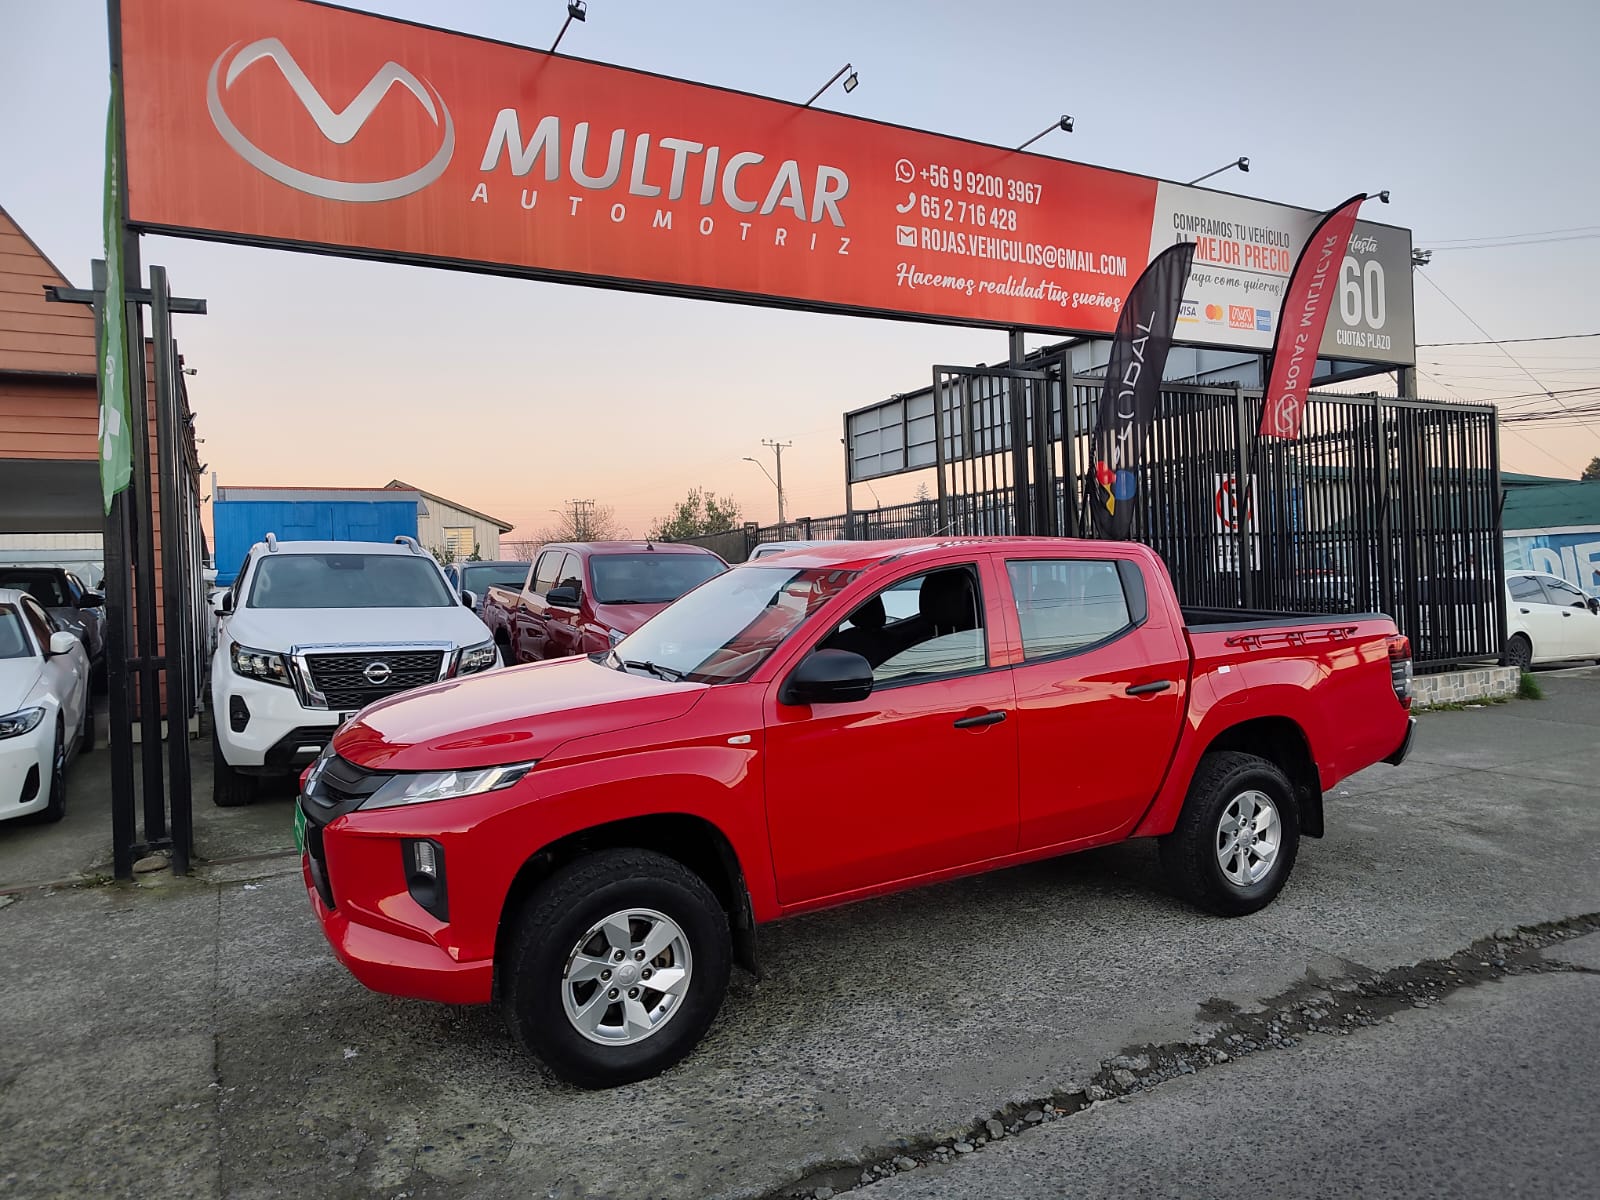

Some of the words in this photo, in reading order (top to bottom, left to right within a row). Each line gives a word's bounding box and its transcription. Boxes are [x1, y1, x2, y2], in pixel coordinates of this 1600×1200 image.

[479, 107, 850, 228] MULTICAR
[919, 163, 949, 189] +56
[953, 168, 963, 192] 9
[966, 173, 1004, 199] 9200
[1007, 179, 1043, 205] 3967
[471, 182, 851, 256] AUTOMOTRIZ
[920, 194, 940, 220] 65
[944, 199, 954, 222] 2
[958, 201, 986, 227] 716
[989, 207, 1017, 232] 428
[1173, 212, 1233, 239] COMPRAMOS
[1234, 223, 1246, 241] TU
[1248, 226, 1290, 249] VEHÍCULO
[921, 226, 1128, 278] ROJAS.VEHICULOS@GMAIL.COM
[1196, 235, 1241, 265] MEJOR
[1244, 244, 1290, 273] PRECIO
[1348, 233, 1378, 255] Hasta
[896, 262, 976, 296] Hacemos
[978, 275, 1045, 301] realidad
[1042, 281, 1070, 308] tus
[1072, 291, 1122, 313] sueños
[1191, 272, 1212, 288] aga
[1214, 275, 1241, 288] como
[1339, 255, 1386, 330] 60
[1336, 329, 1366, 348] CUOTAS
[1367, 332, 1391, 350] PLAZO
